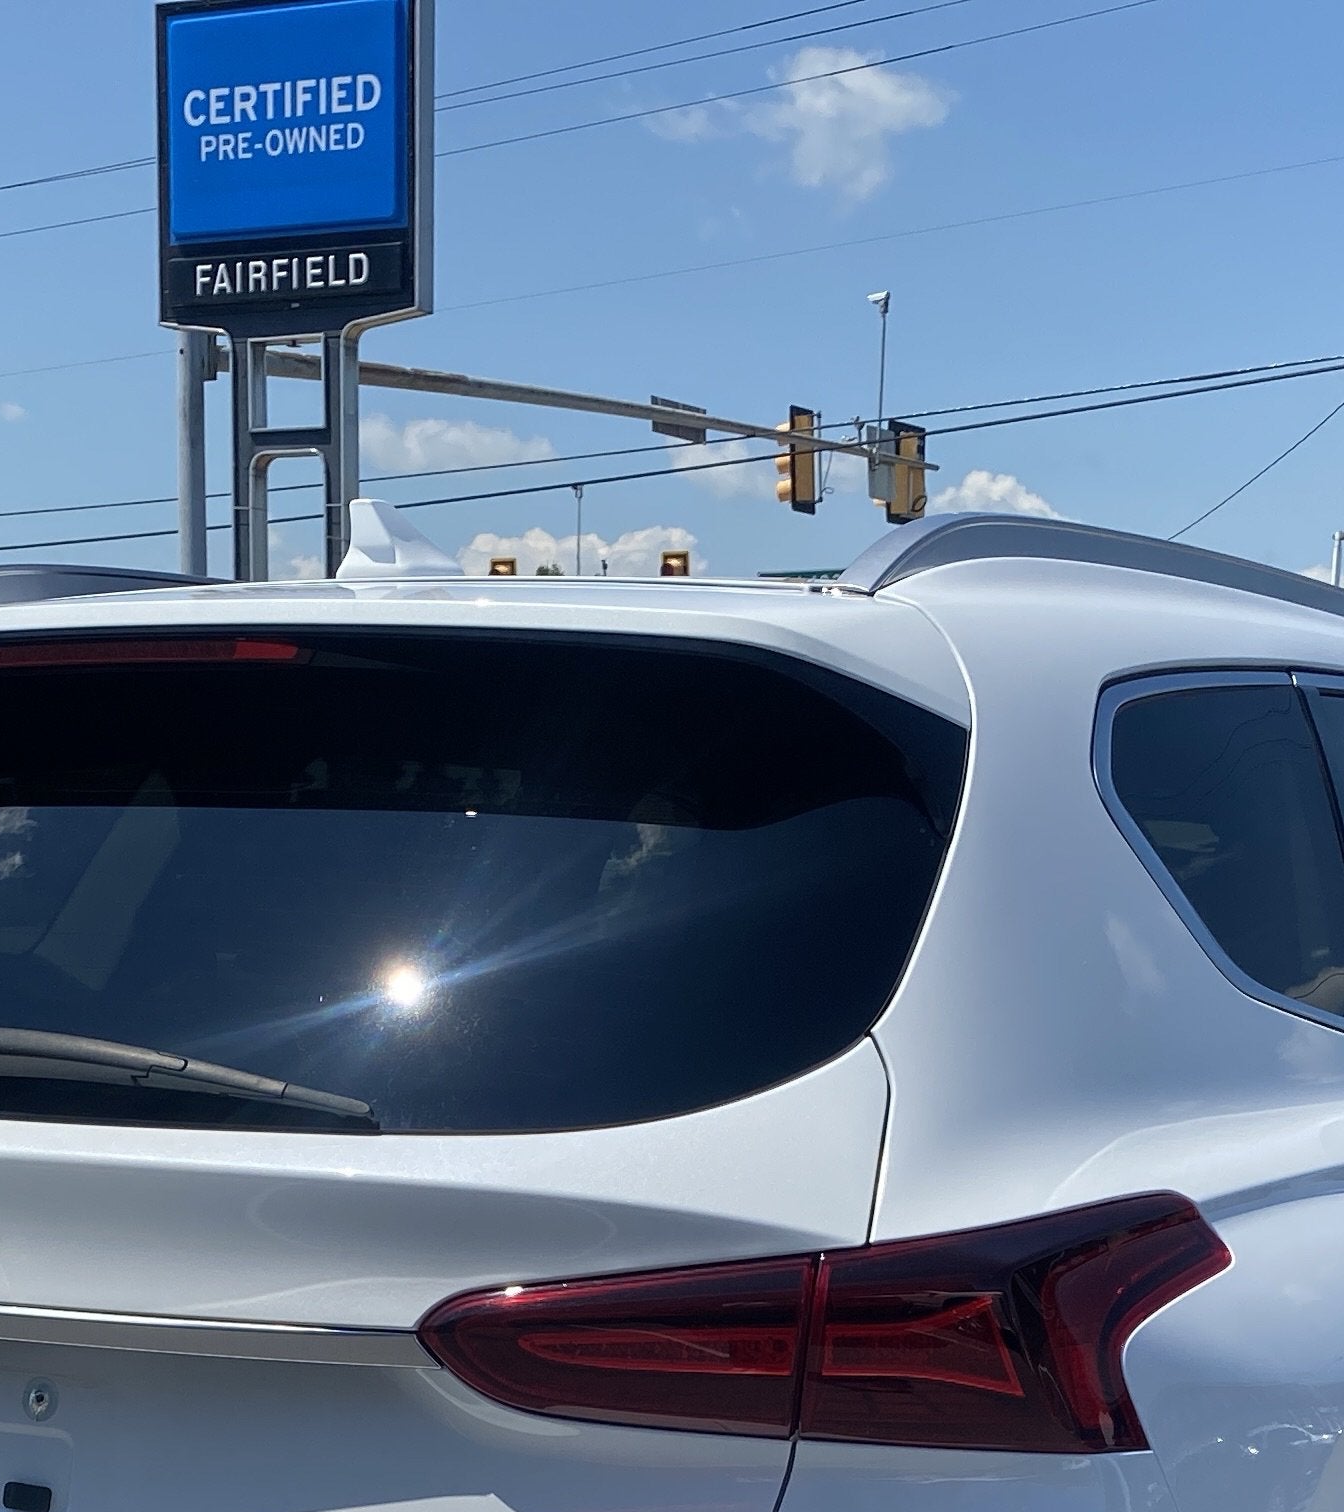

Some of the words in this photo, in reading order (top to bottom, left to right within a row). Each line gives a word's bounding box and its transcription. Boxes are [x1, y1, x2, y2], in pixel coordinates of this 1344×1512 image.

[183, 73, 382, 127] CERTIFIED
[200, 122, 365, 162] PRE-OWNED
[194, 252, 370, 297] FAIRFIELD
